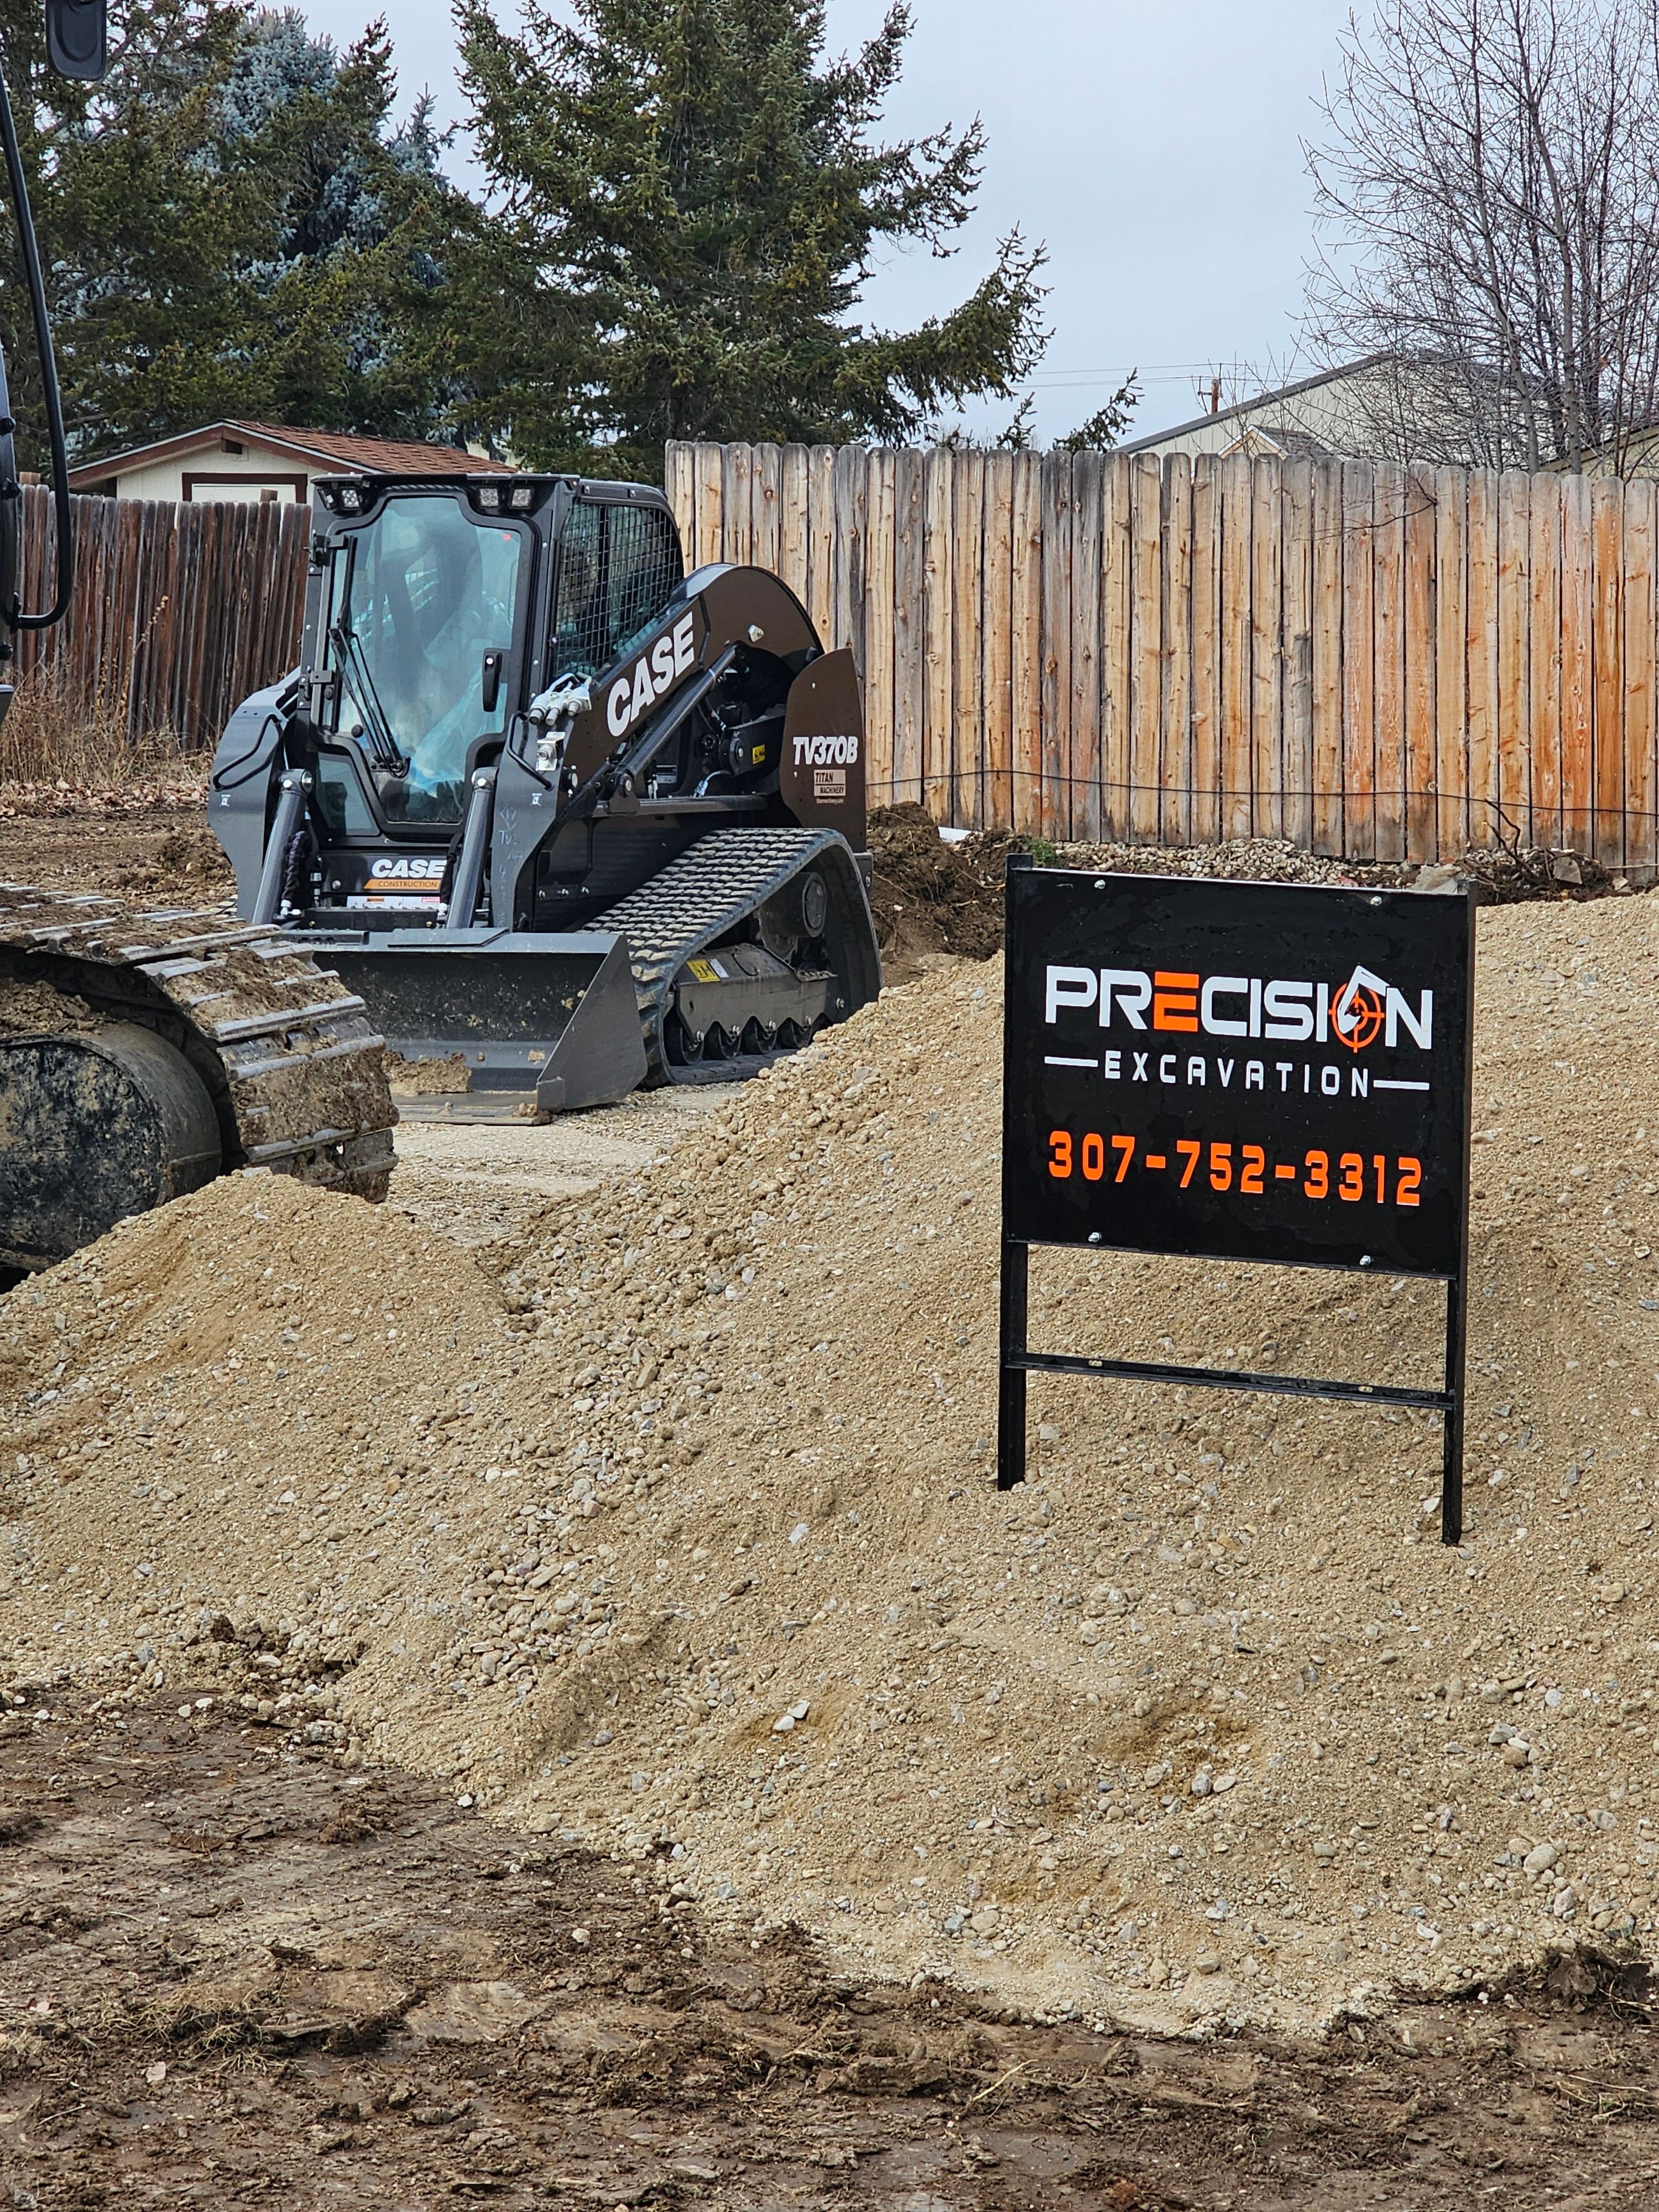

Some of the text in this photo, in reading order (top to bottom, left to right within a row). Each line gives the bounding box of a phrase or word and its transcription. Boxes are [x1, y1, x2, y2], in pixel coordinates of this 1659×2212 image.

[607, 611, 695, 737] CASE
[792, 735, 858, 765] TV370B
[815, 772, 833, 783] TITAN
[371, 859, 447, 878] CASE
[1045, 965, 1433, 1053] PRECISION
[1105, 1050, 1369, 1098] EXCAVATION
[1048, 1131, 1422, 1207] 307-752-3312
